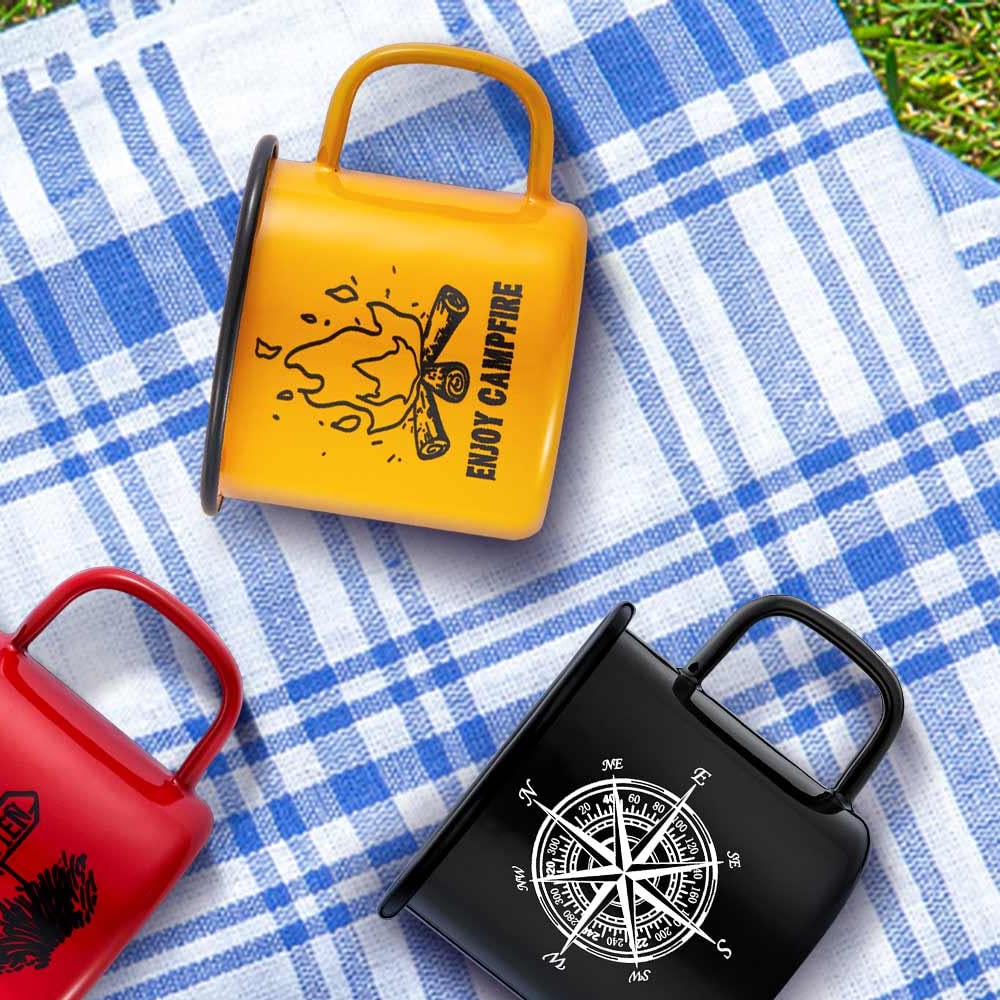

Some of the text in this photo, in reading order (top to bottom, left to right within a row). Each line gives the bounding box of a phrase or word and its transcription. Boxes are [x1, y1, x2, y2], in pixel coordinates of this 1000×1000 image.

[465, 281, 524, 481] ENJOY CAMPFIRE
[601, 758, 624, 772] NE
[690, 767, 712, 786] E
[518, 778, 538, 807] N
[628, 793, 641, 804] 60
[578, 802, 591, 815] 20
[652, 801, 665, 813] 80
[672, 815, 688, 833] 100
[546, 837, 561, 856] 300
[684, 837, 700, 855] 120
[716, 938, 733, 960] S
